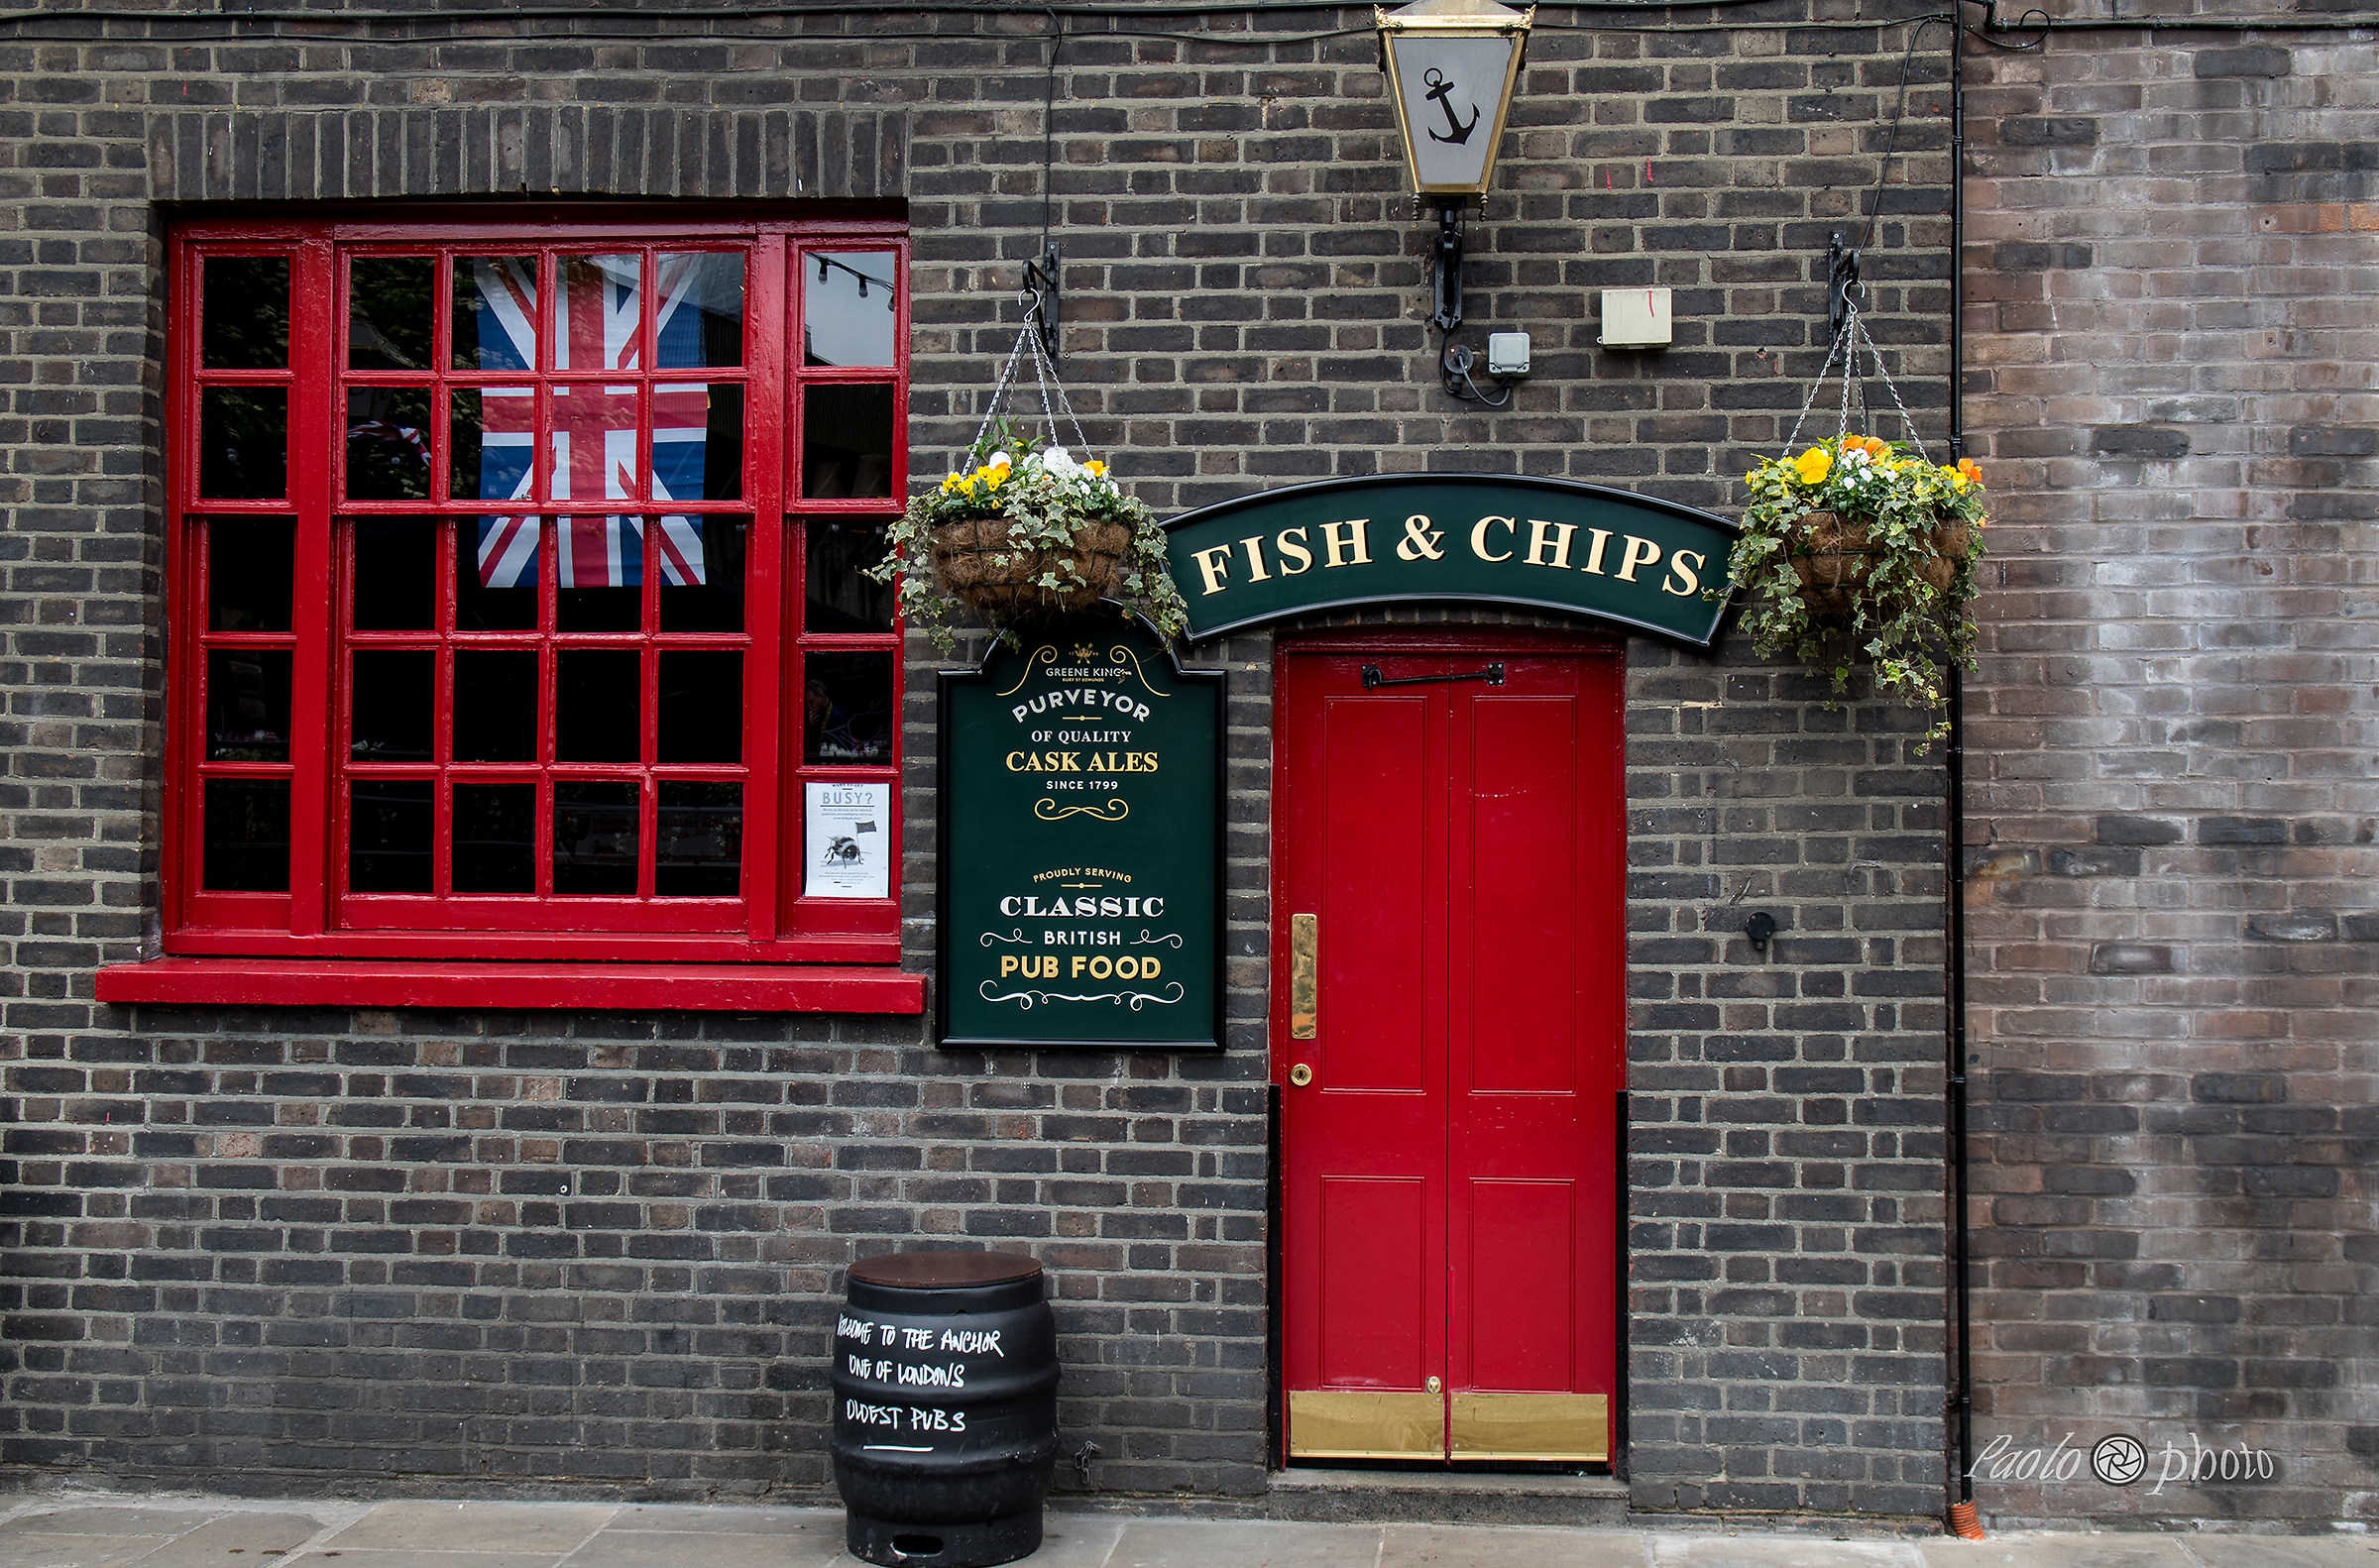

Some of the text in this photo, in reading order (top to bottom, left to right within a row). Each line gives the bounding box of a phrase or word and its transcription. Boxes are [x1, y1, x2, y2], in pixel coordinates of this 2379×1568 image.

[1190, 514, 1707, 597] FISH & CHIPS
[1045, 667, 1121, 677] GREENE KING
[1011, 688, 1151, 724] PURVEYOR
[1031, 729, 1132, 744] OF QUALITY
[1005, 751, 1159, 773] CASK ALES
[1046, 780, 1118, 790] SINCE 1799
[822, 792, 873, 805] BUSY?
[1033, 867, 1132, 883] PROUDLY SERVING
[999, 896, 1165, 918] CLASSIC
[1044, 930, 1121, 946] BRITISH
[1001, 955, 1162, 980] PUB FOOD
[880, 1324, 896, 1346] TO
[901, 1327, 934, 1350] THE
[940, 1328, 1005, 1358] ANCHOR
[849, 1354, 872, 1380] ONE
[876, 1360, 893, 1384] OF
[847, 1399, 966, 1432] OLDEST PUBS
